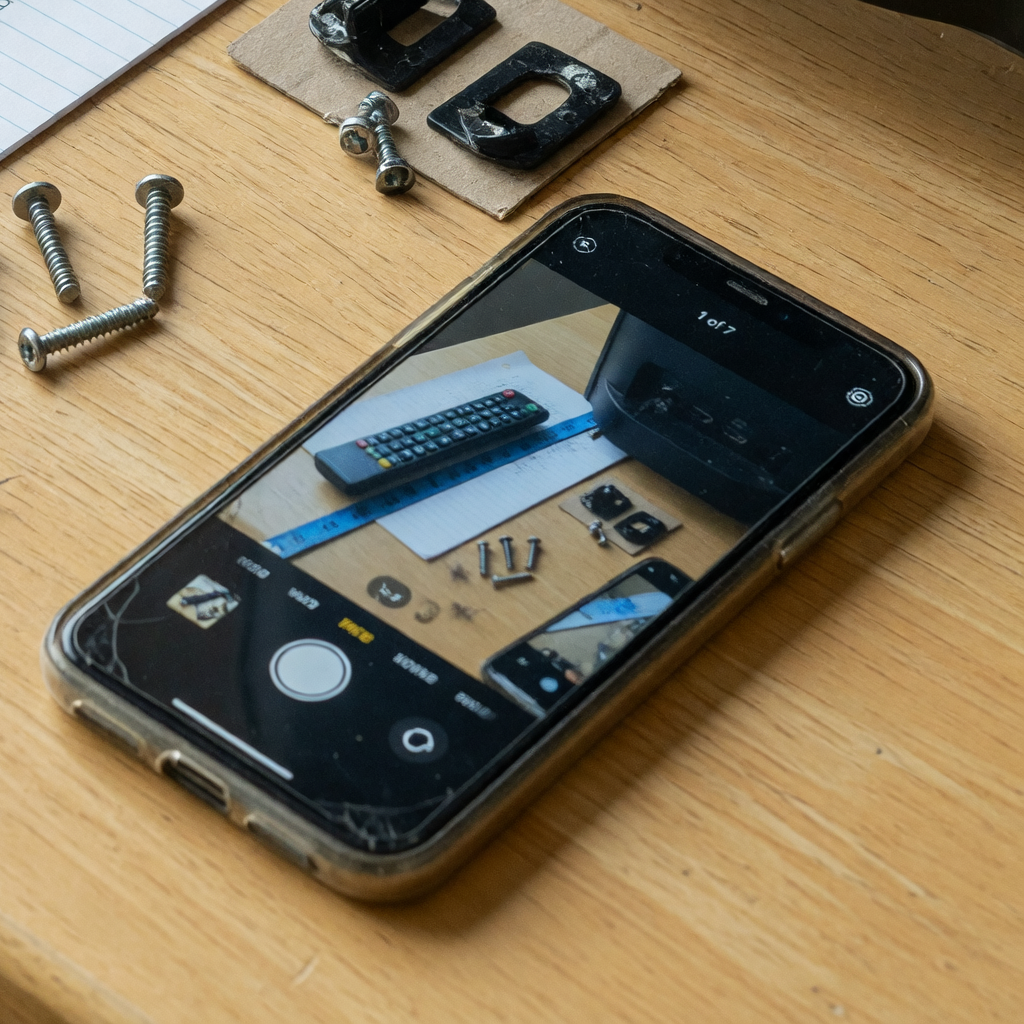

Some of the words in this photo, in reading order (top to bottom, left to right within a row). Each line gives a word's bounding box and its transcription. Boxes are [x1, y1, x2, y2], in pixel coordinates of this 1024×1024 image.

[697, 311, 708, 320] 1
[707, 318, 727, 329] of
[722, 325, 736, 334] 7
